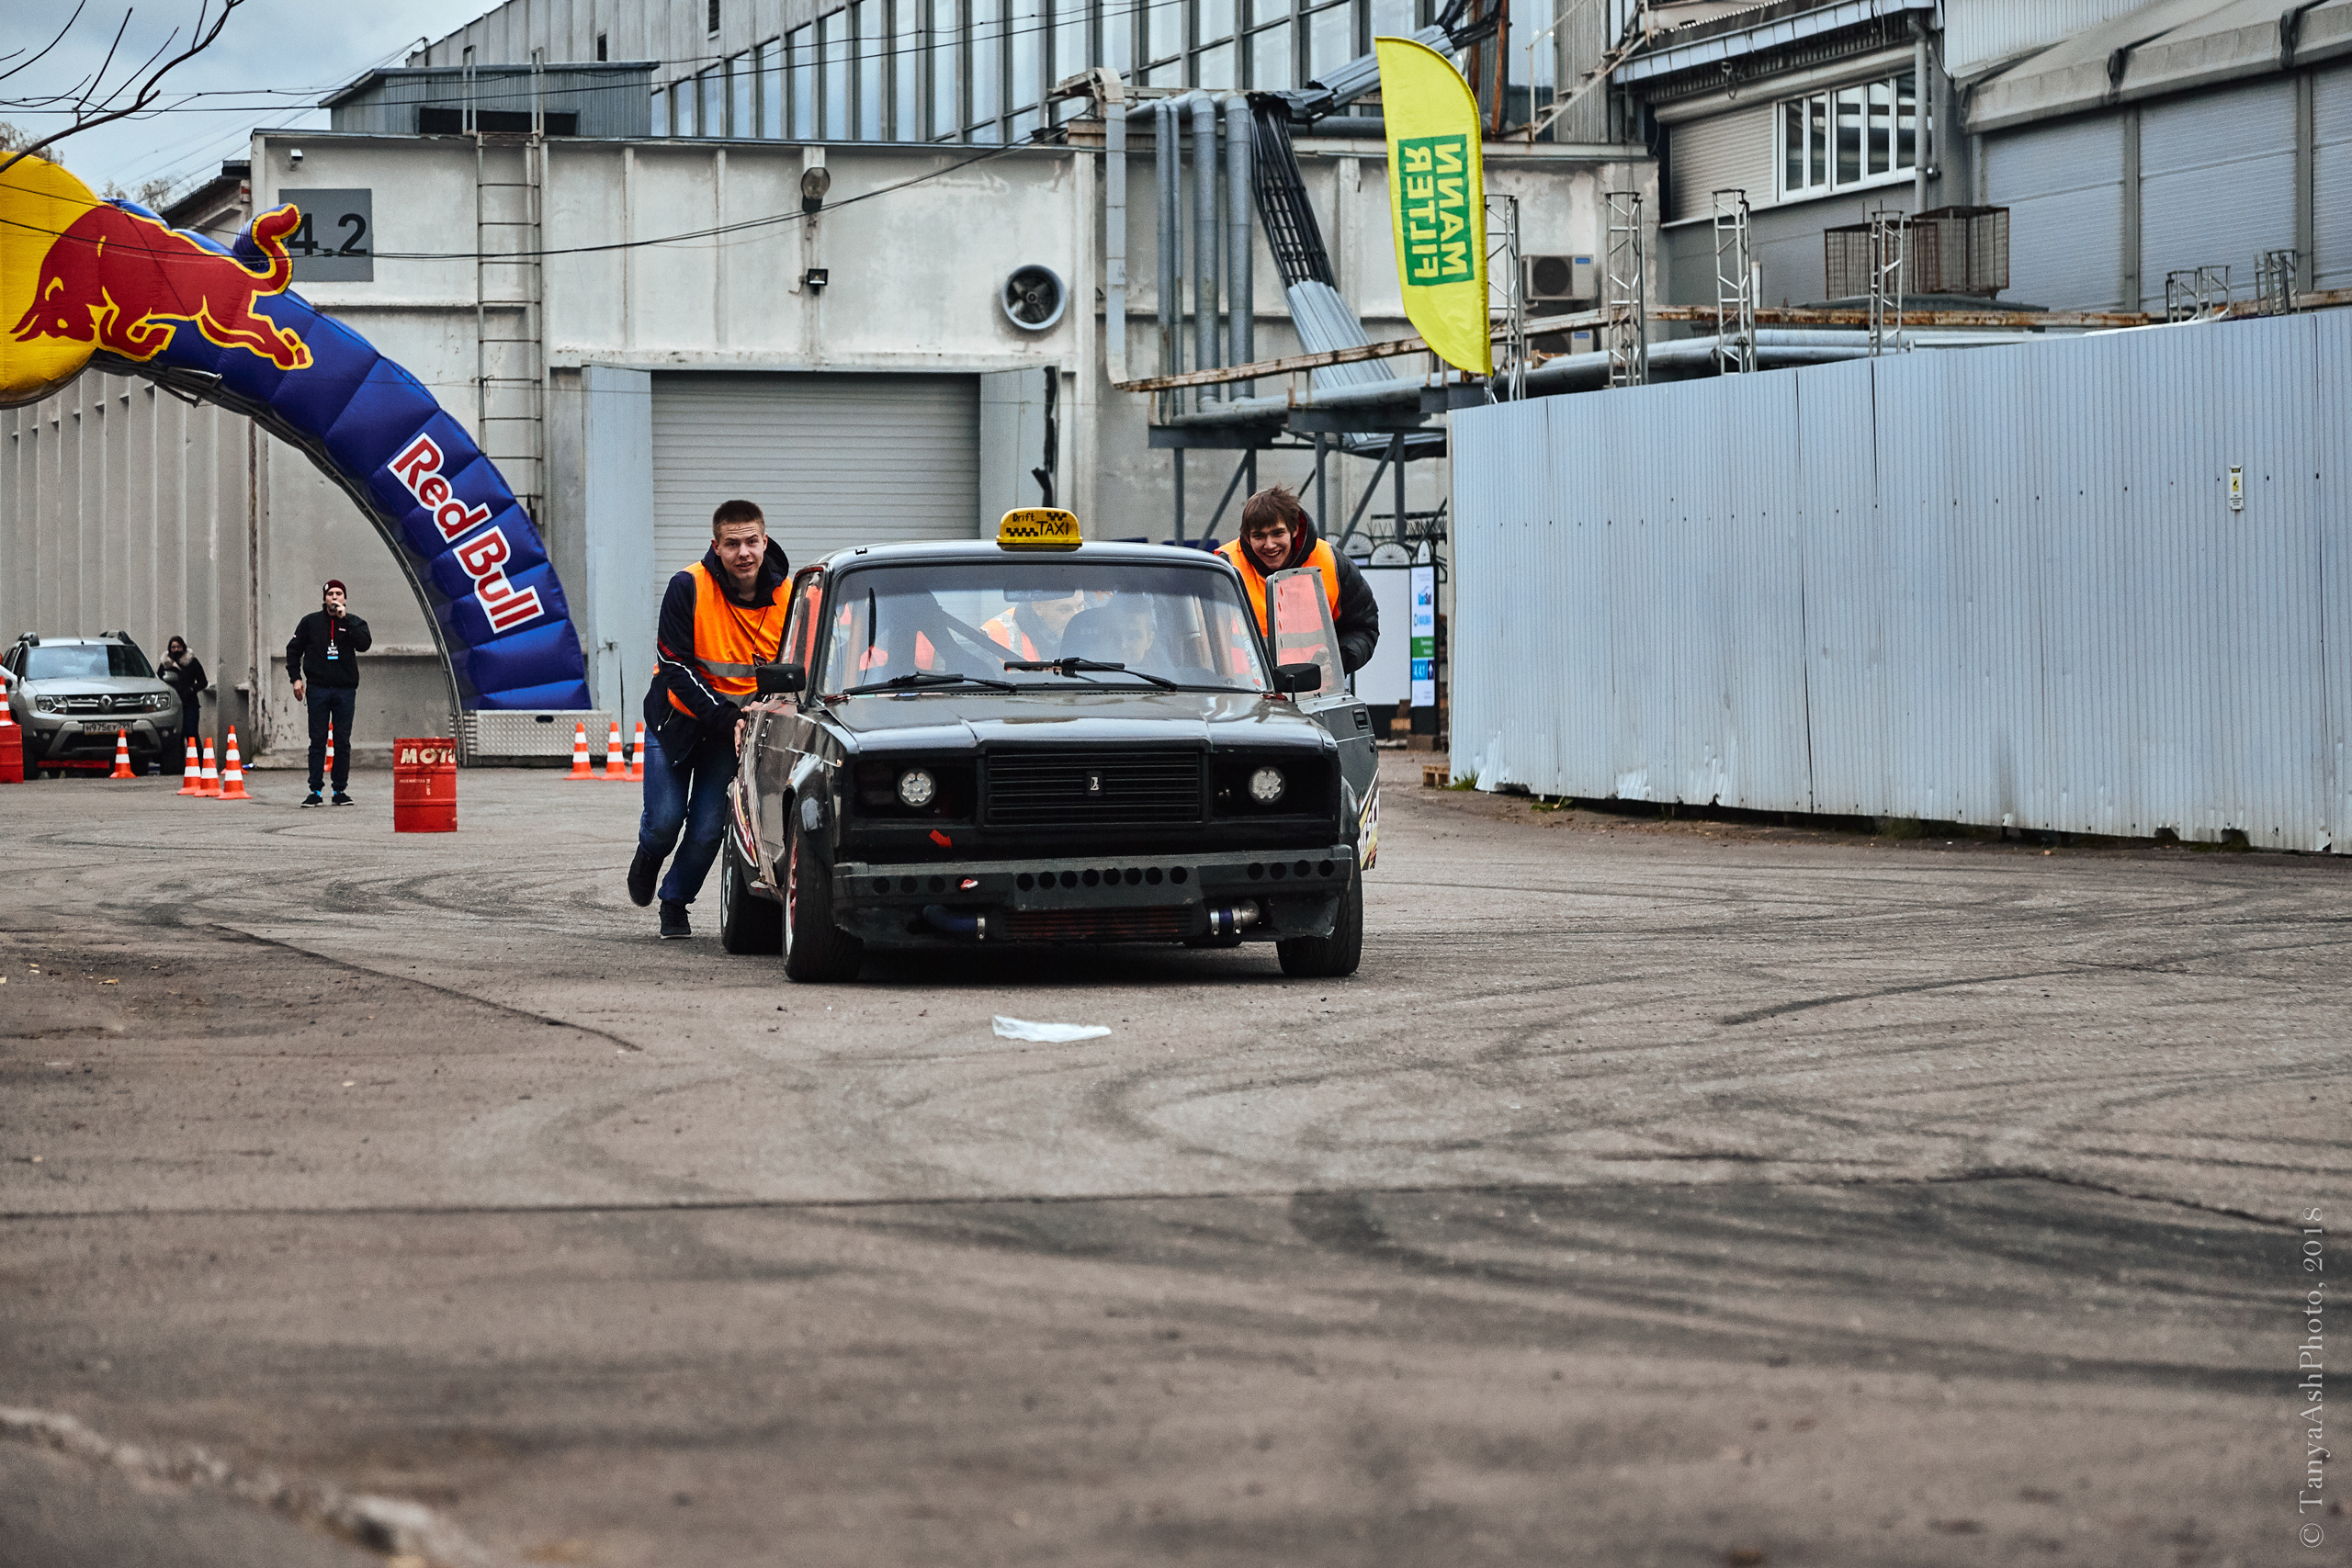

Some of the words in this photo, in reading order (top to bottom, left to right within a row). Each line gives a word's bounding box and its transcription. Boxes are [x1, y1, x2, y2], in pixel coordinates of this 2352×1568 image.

[288, 212, 368, 257] 4.2
[1012, 512, 1035, 523] Drift
[1036, 520, 1069, 536] TAXI
[389, 434, 491, 542] Red
[454, 526, 544, 632] Bull
